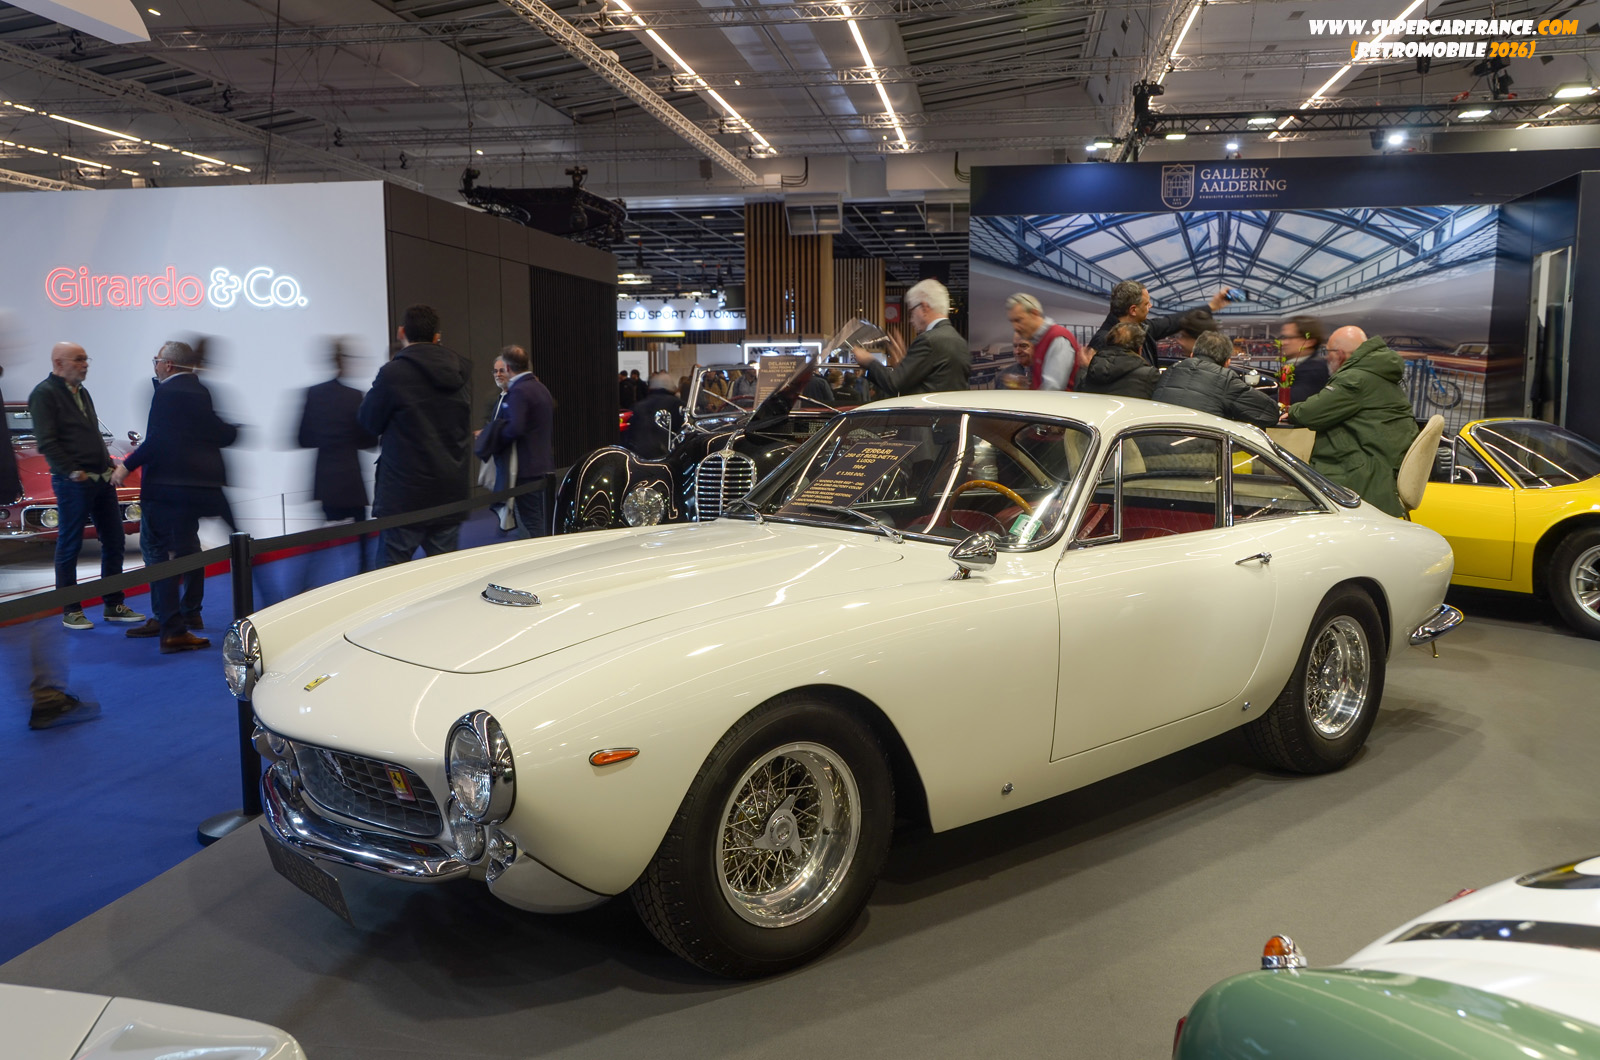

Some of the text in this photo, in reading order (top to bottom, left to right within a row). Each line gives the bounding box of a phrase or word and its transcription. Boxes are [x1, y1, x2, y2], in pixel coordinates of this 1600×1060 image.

[1200, 167, 1269, 180] GALLERY
[1200, 180, 1287, 193] AALDERING
[45, 266, 205, 307] Girardo
[629, 310, 646, 320] DU
[648, 310, 686, 320] SPORT
[861, 447, 894, 455] FERRARI
[863, 453, 899, 461] BERLINETTA
